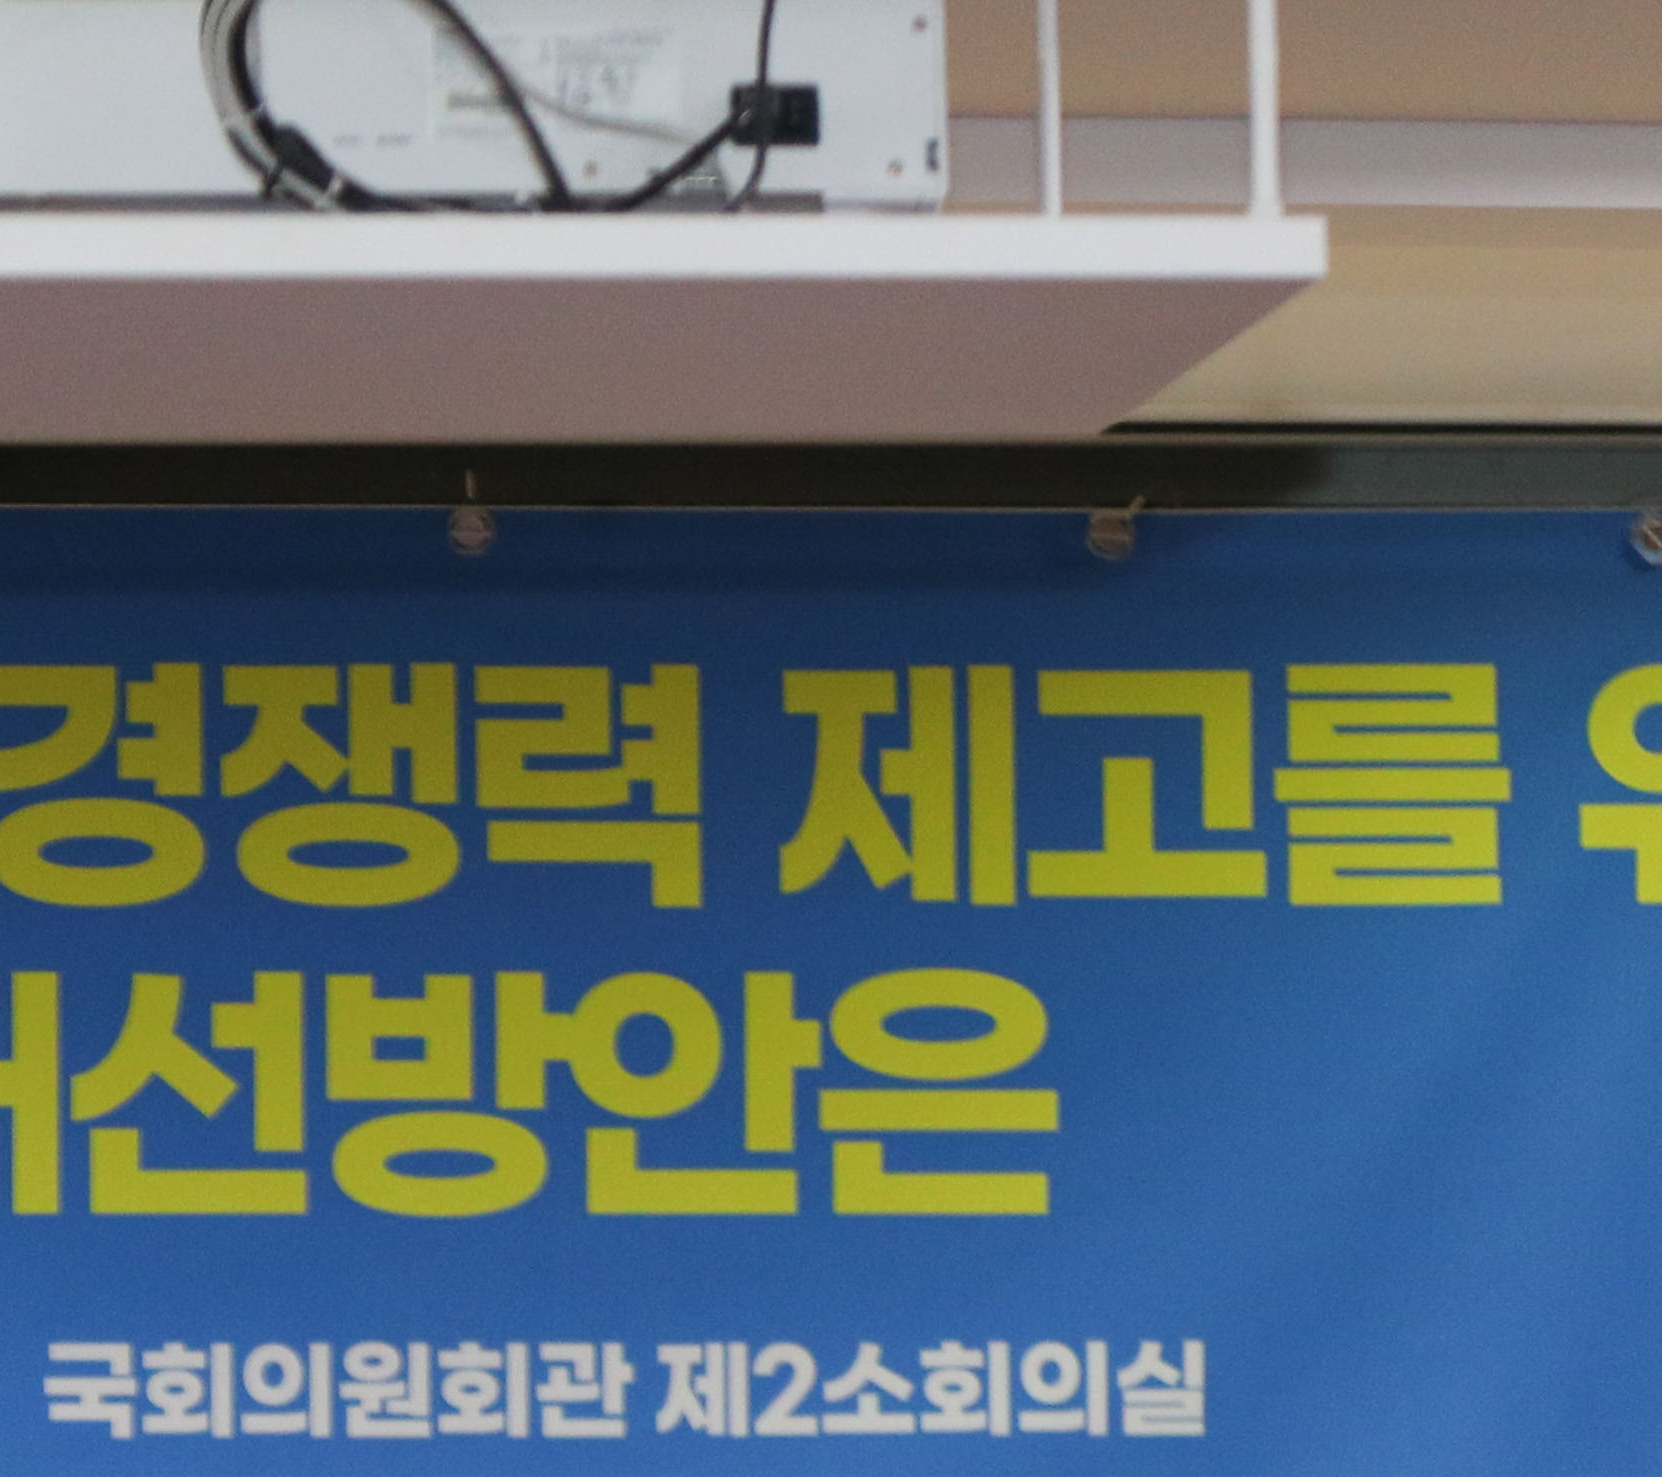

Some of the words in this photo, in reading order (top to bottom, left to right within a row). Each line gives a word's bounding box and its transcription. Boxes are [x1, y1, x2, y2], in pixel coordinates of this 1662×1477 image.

[778, 661, 1513, 908] 제고를
[41, 1340, 635, 1441] 국회의원회관
[655, 1339, 1208, 1440] 제2소회의실
